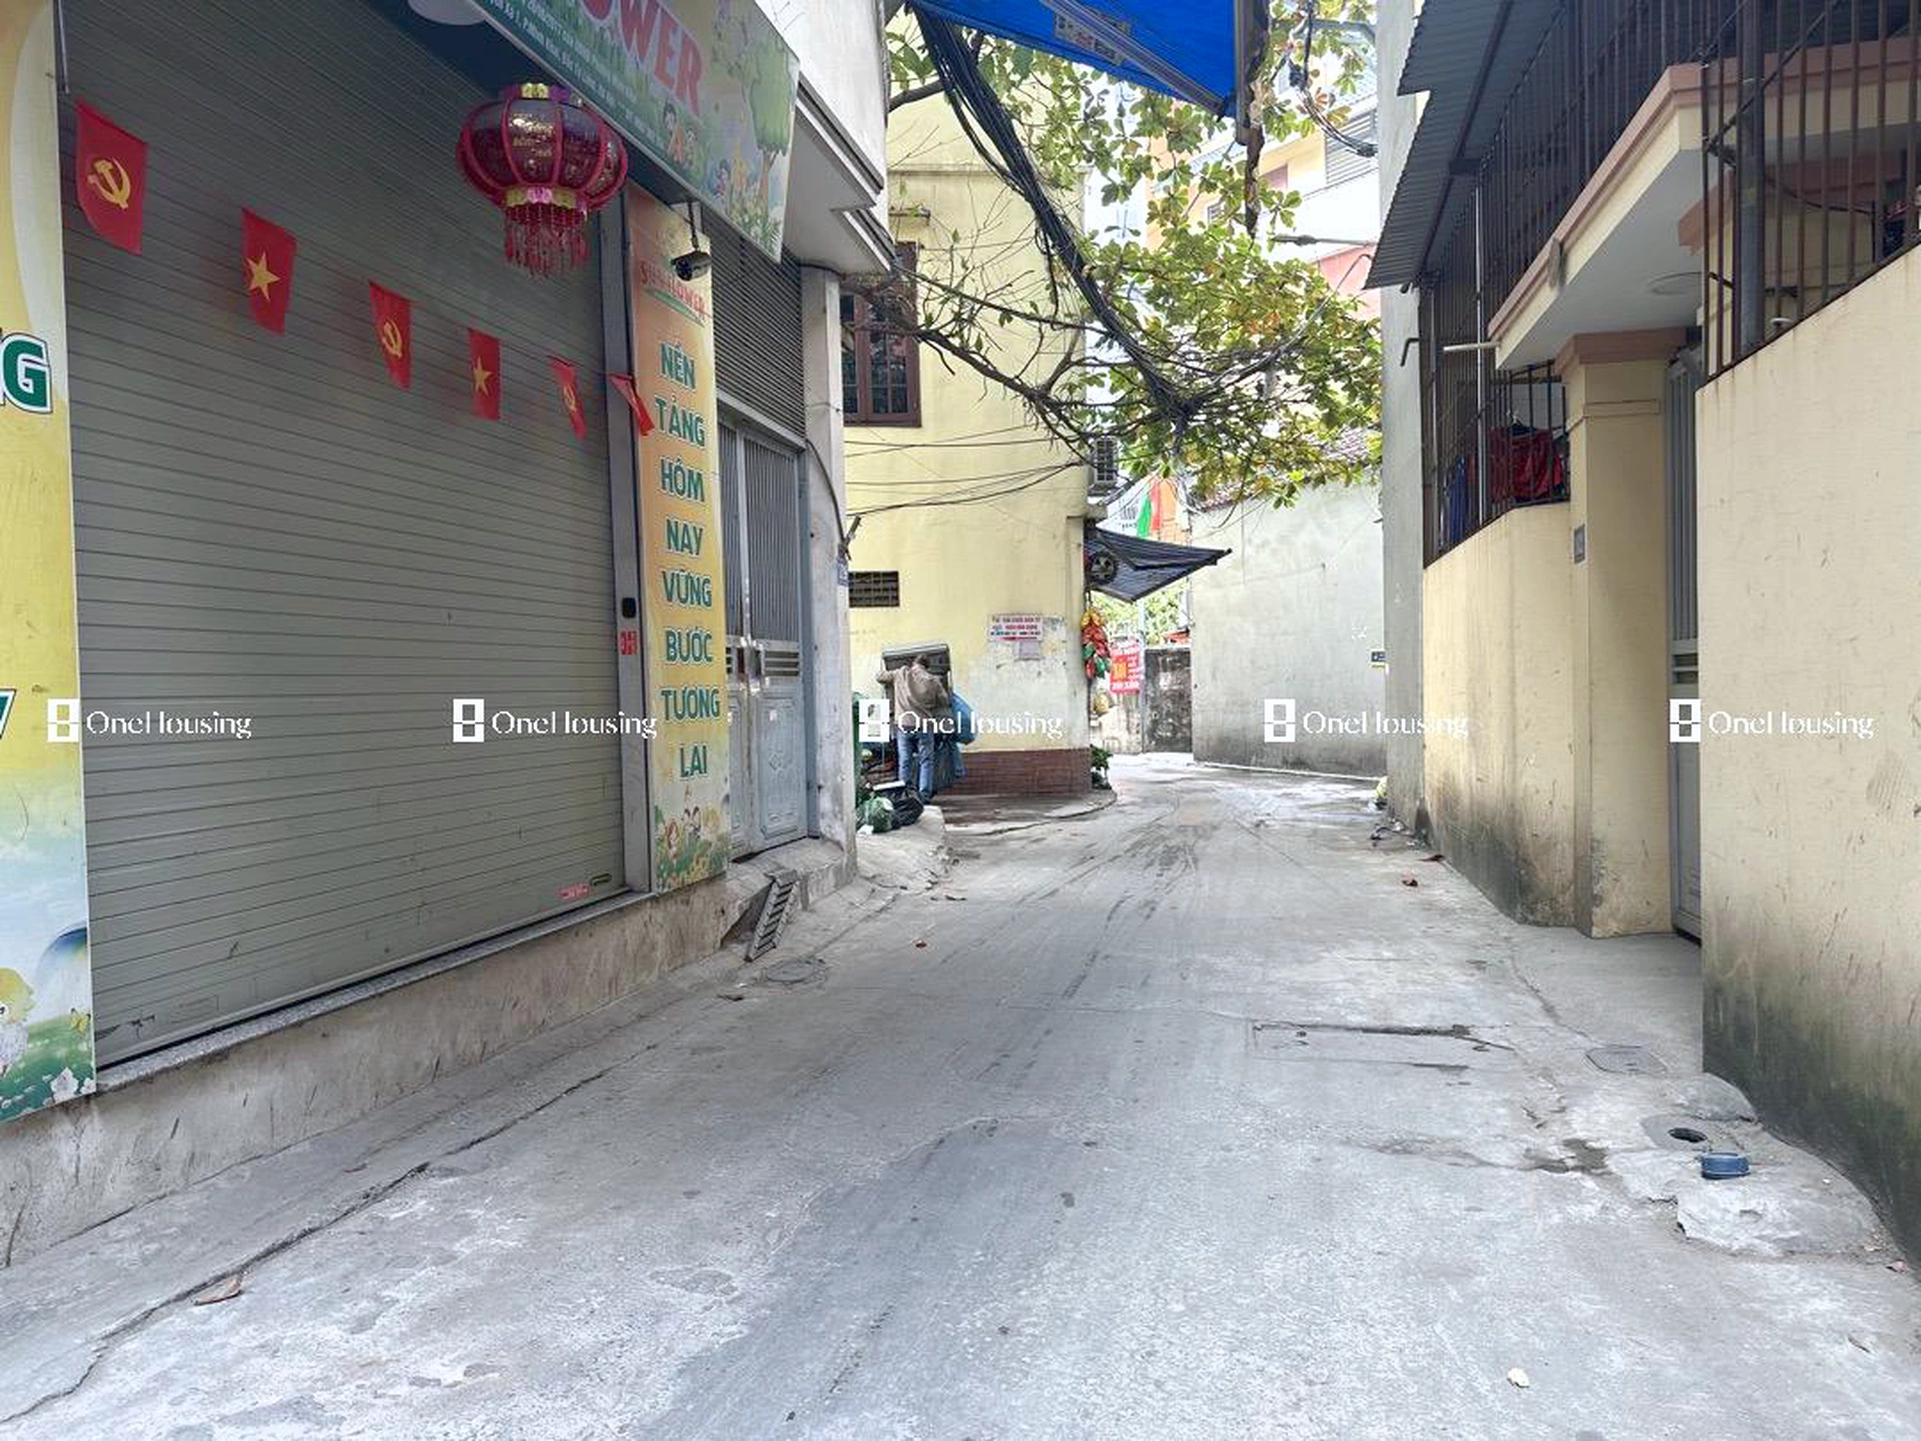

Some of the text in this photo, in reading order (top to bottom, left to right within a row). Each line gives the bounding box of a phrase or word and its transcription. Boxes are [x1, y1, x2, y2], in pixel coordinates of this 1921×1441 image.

[0, 329, 52, 414] G
[655, 394, 706, 447] TẢNG
[660, 457, 705, 502] HÔM
[666, 519, 704, 556] NAY
[661, 568, 712, 607] VỮNG
[665, 626, 713, 663] BƯỚC
[660, 686, 721, 721] TƯƠNG
[680, 745, 708, 778] LAI
